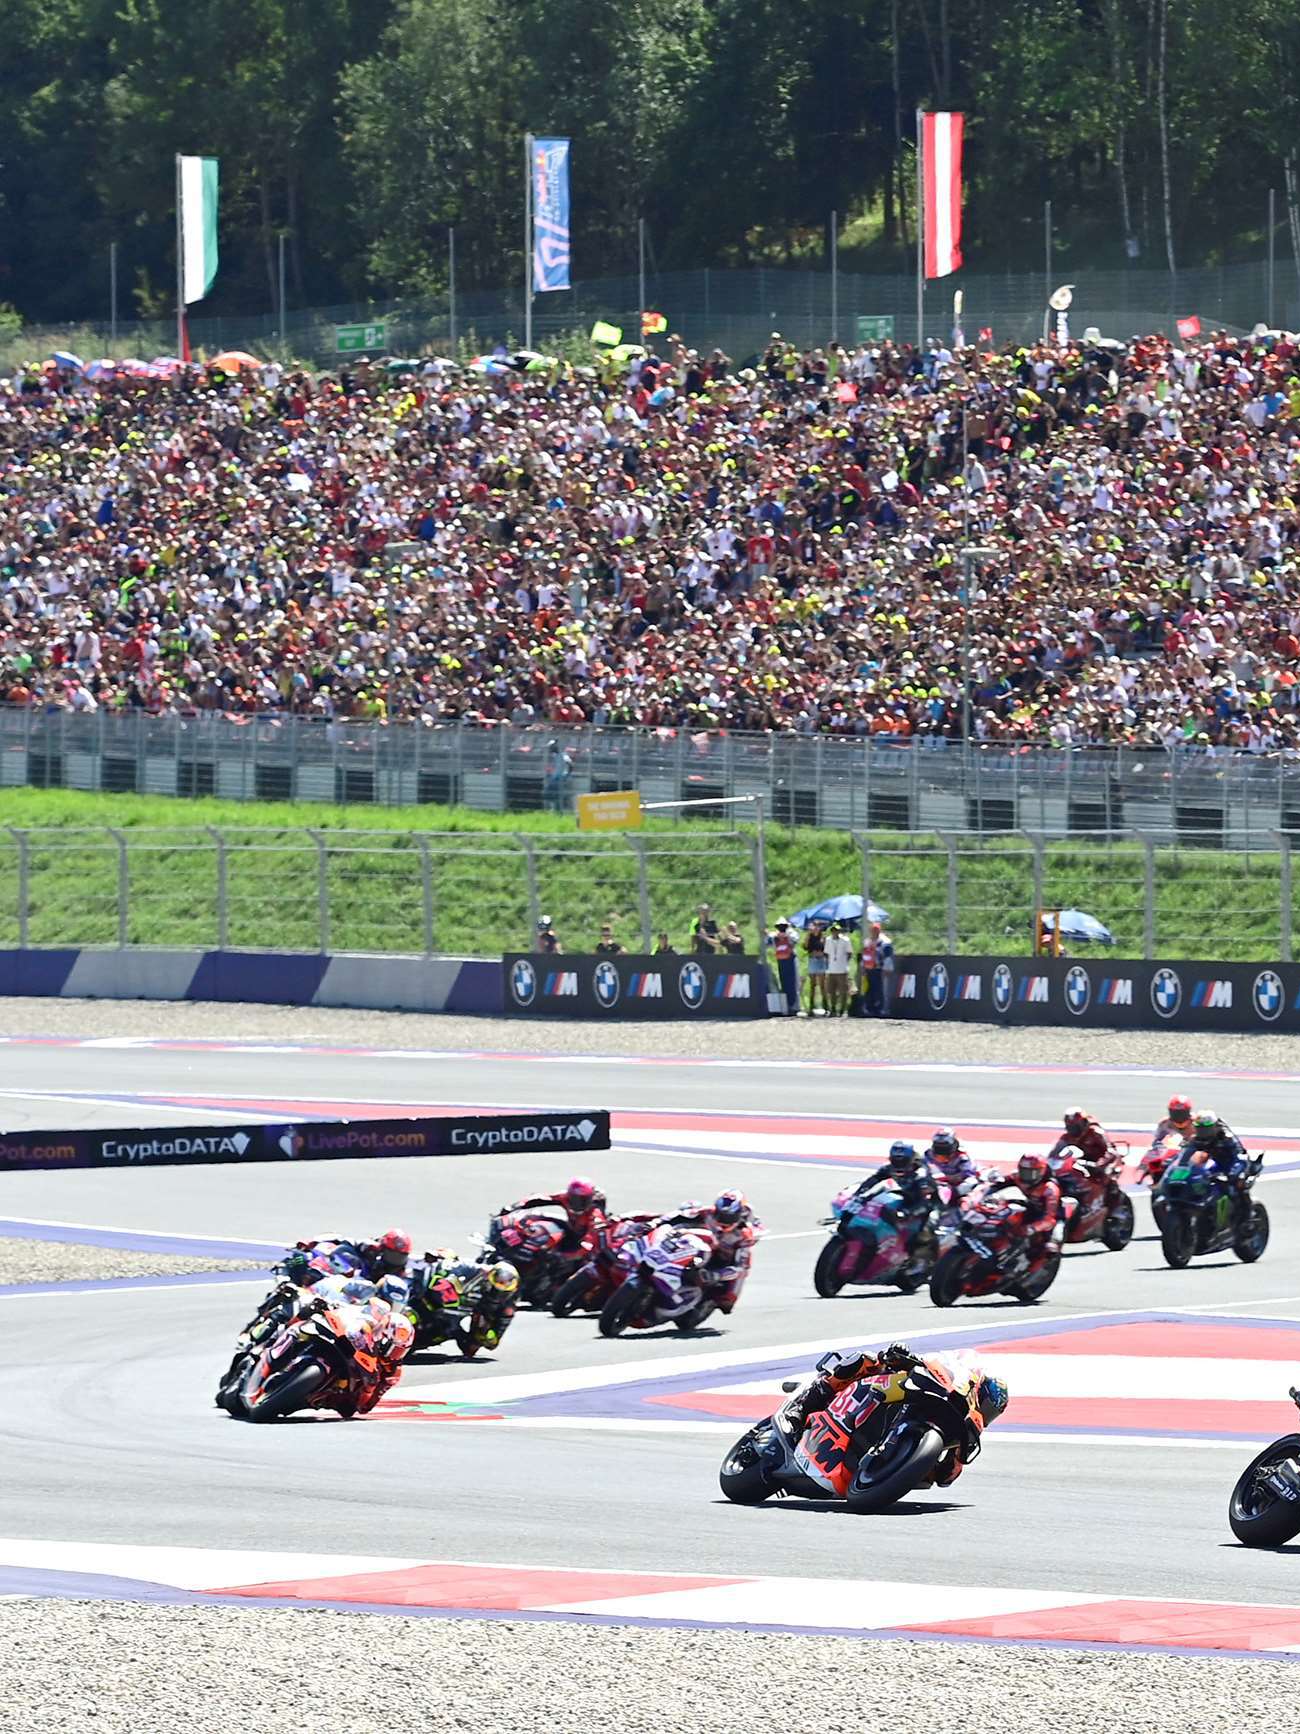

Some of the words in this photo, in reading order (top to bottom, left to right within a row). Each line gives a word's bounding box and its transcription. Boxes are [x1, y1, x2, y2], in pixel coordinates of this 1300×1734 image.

[102, 1137, 233, 1161] CryptoDATA
[308, 1129, 426, 1150] LivePot.com
[451, 1124, 580, 1147] CryptoDATA
